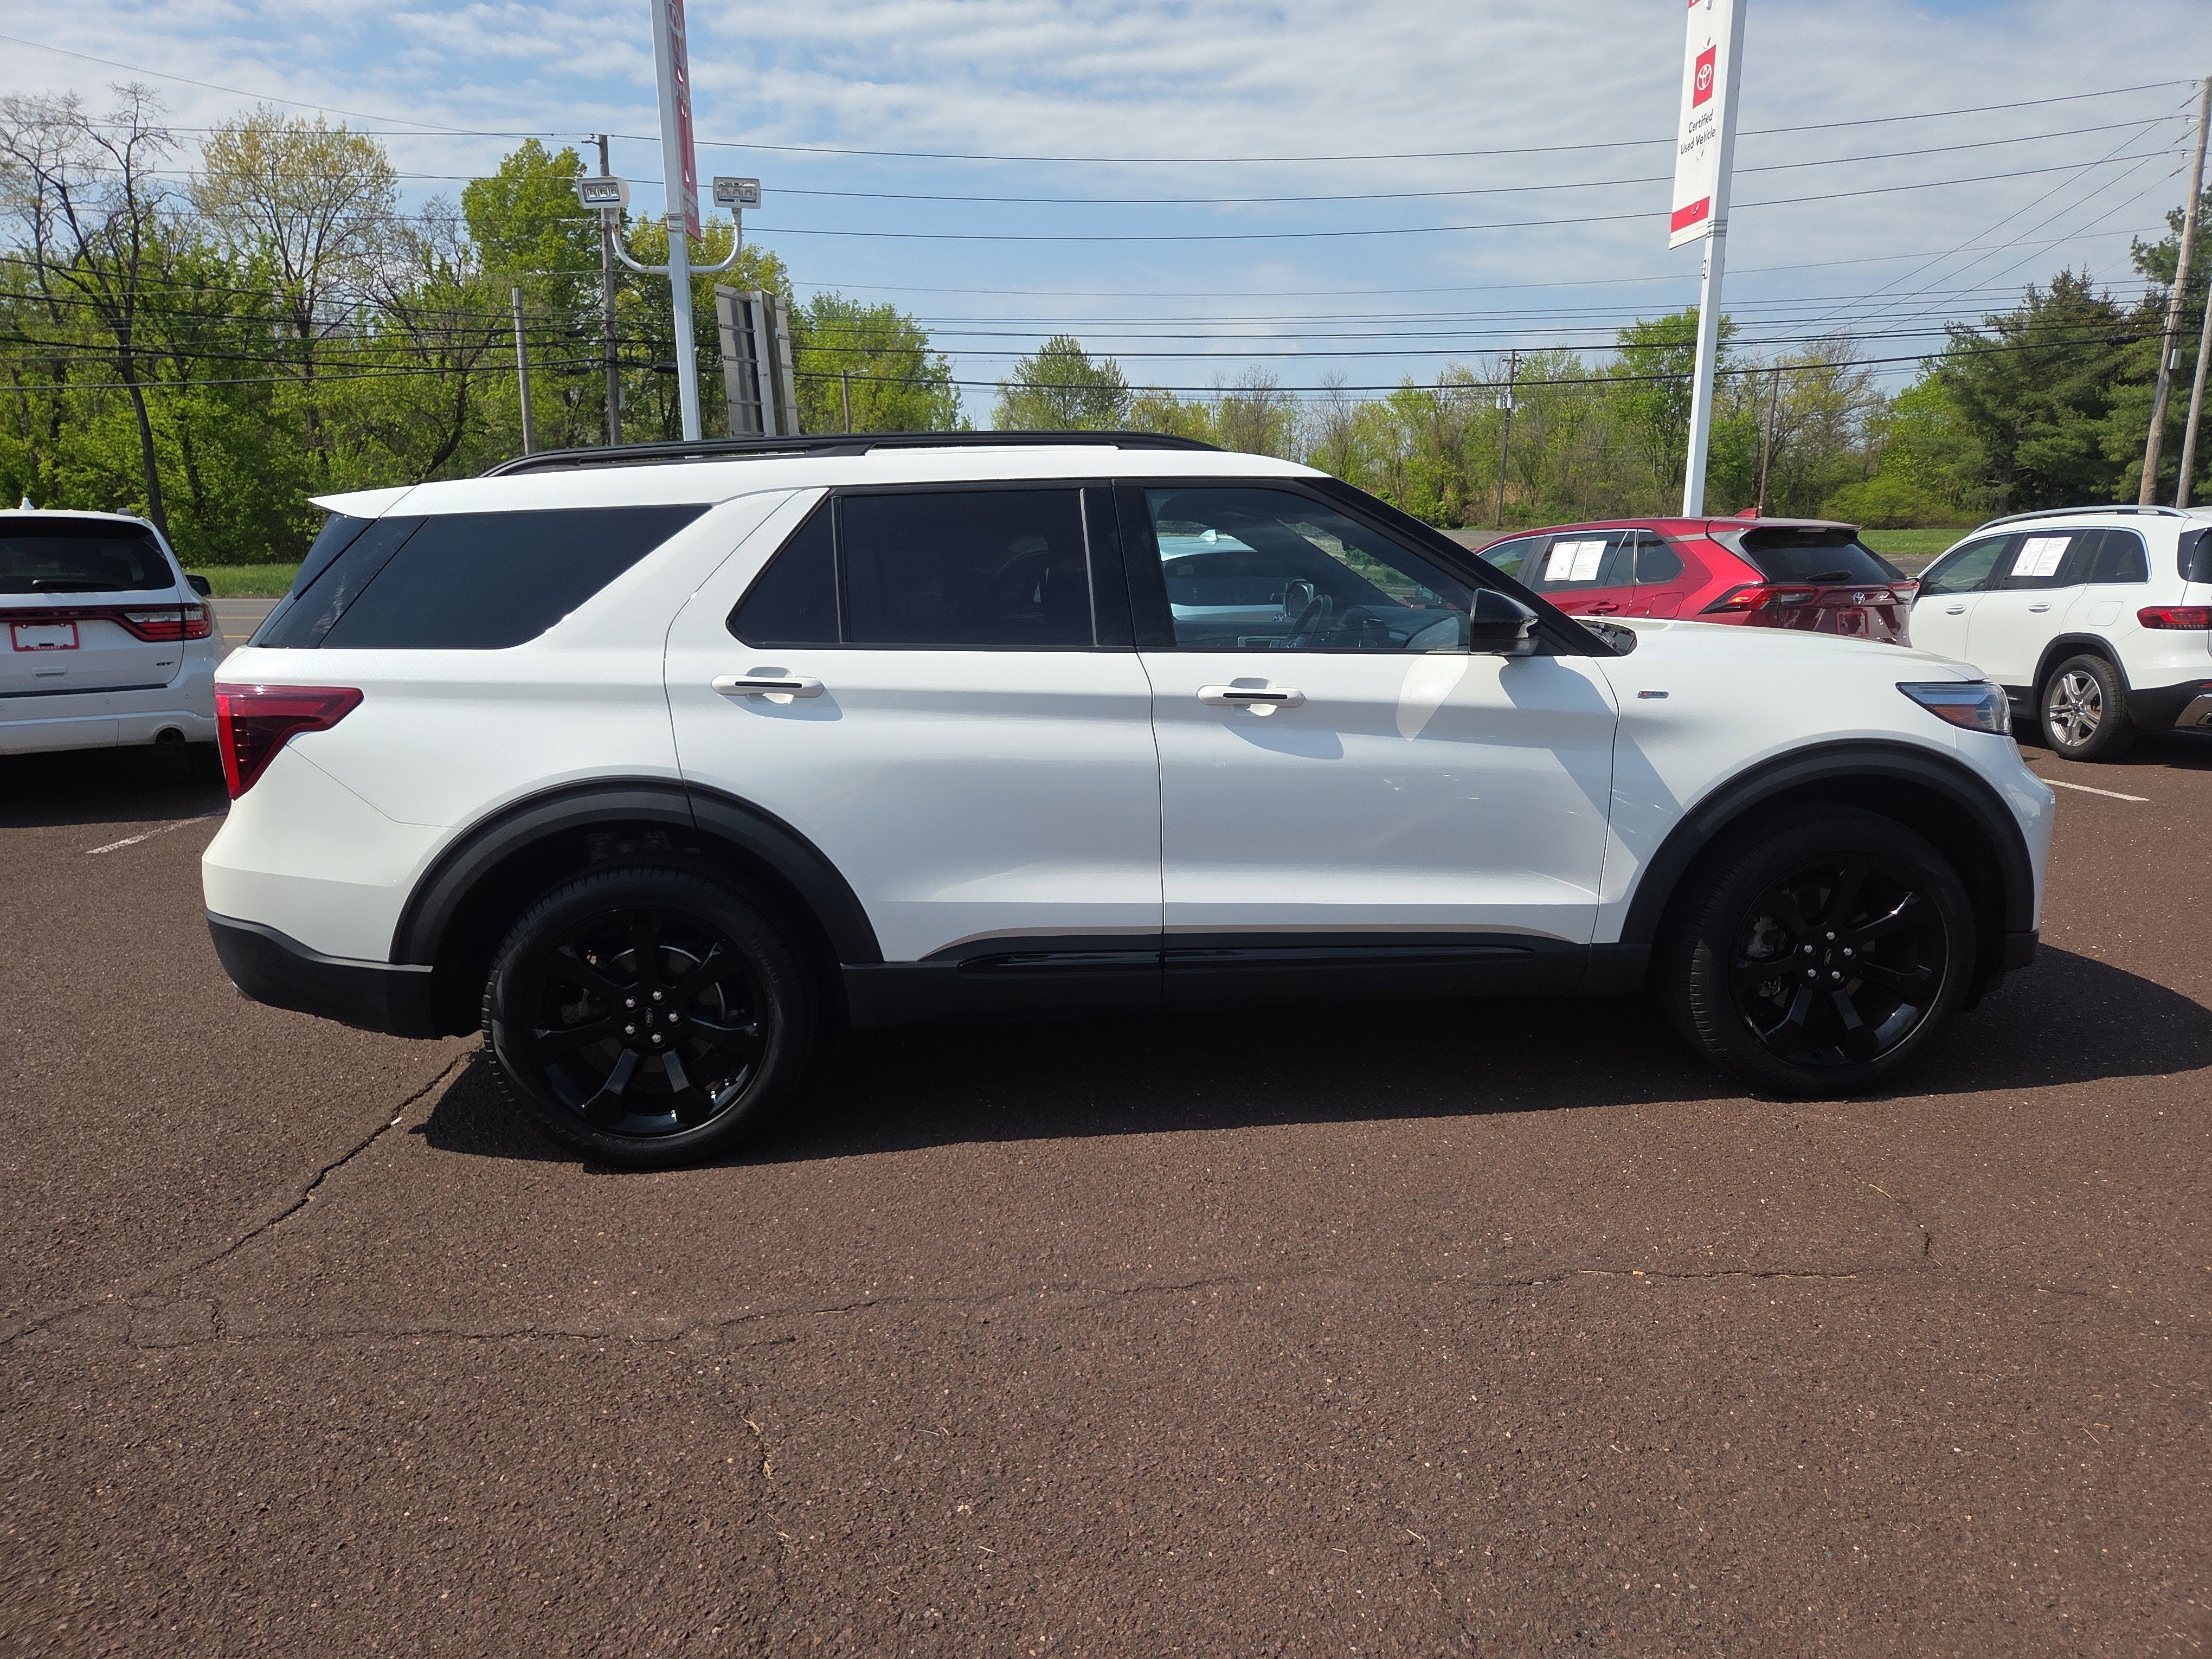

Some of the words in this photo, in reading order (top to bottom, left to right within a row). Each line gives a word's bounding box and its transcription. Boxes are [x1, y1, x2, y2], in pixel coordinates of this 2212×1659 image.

[1688, 108, 1713, 133] Certified
[1681, 136, 1695, 155] Used
[1695, 126, 1716, 146] Vehicle
